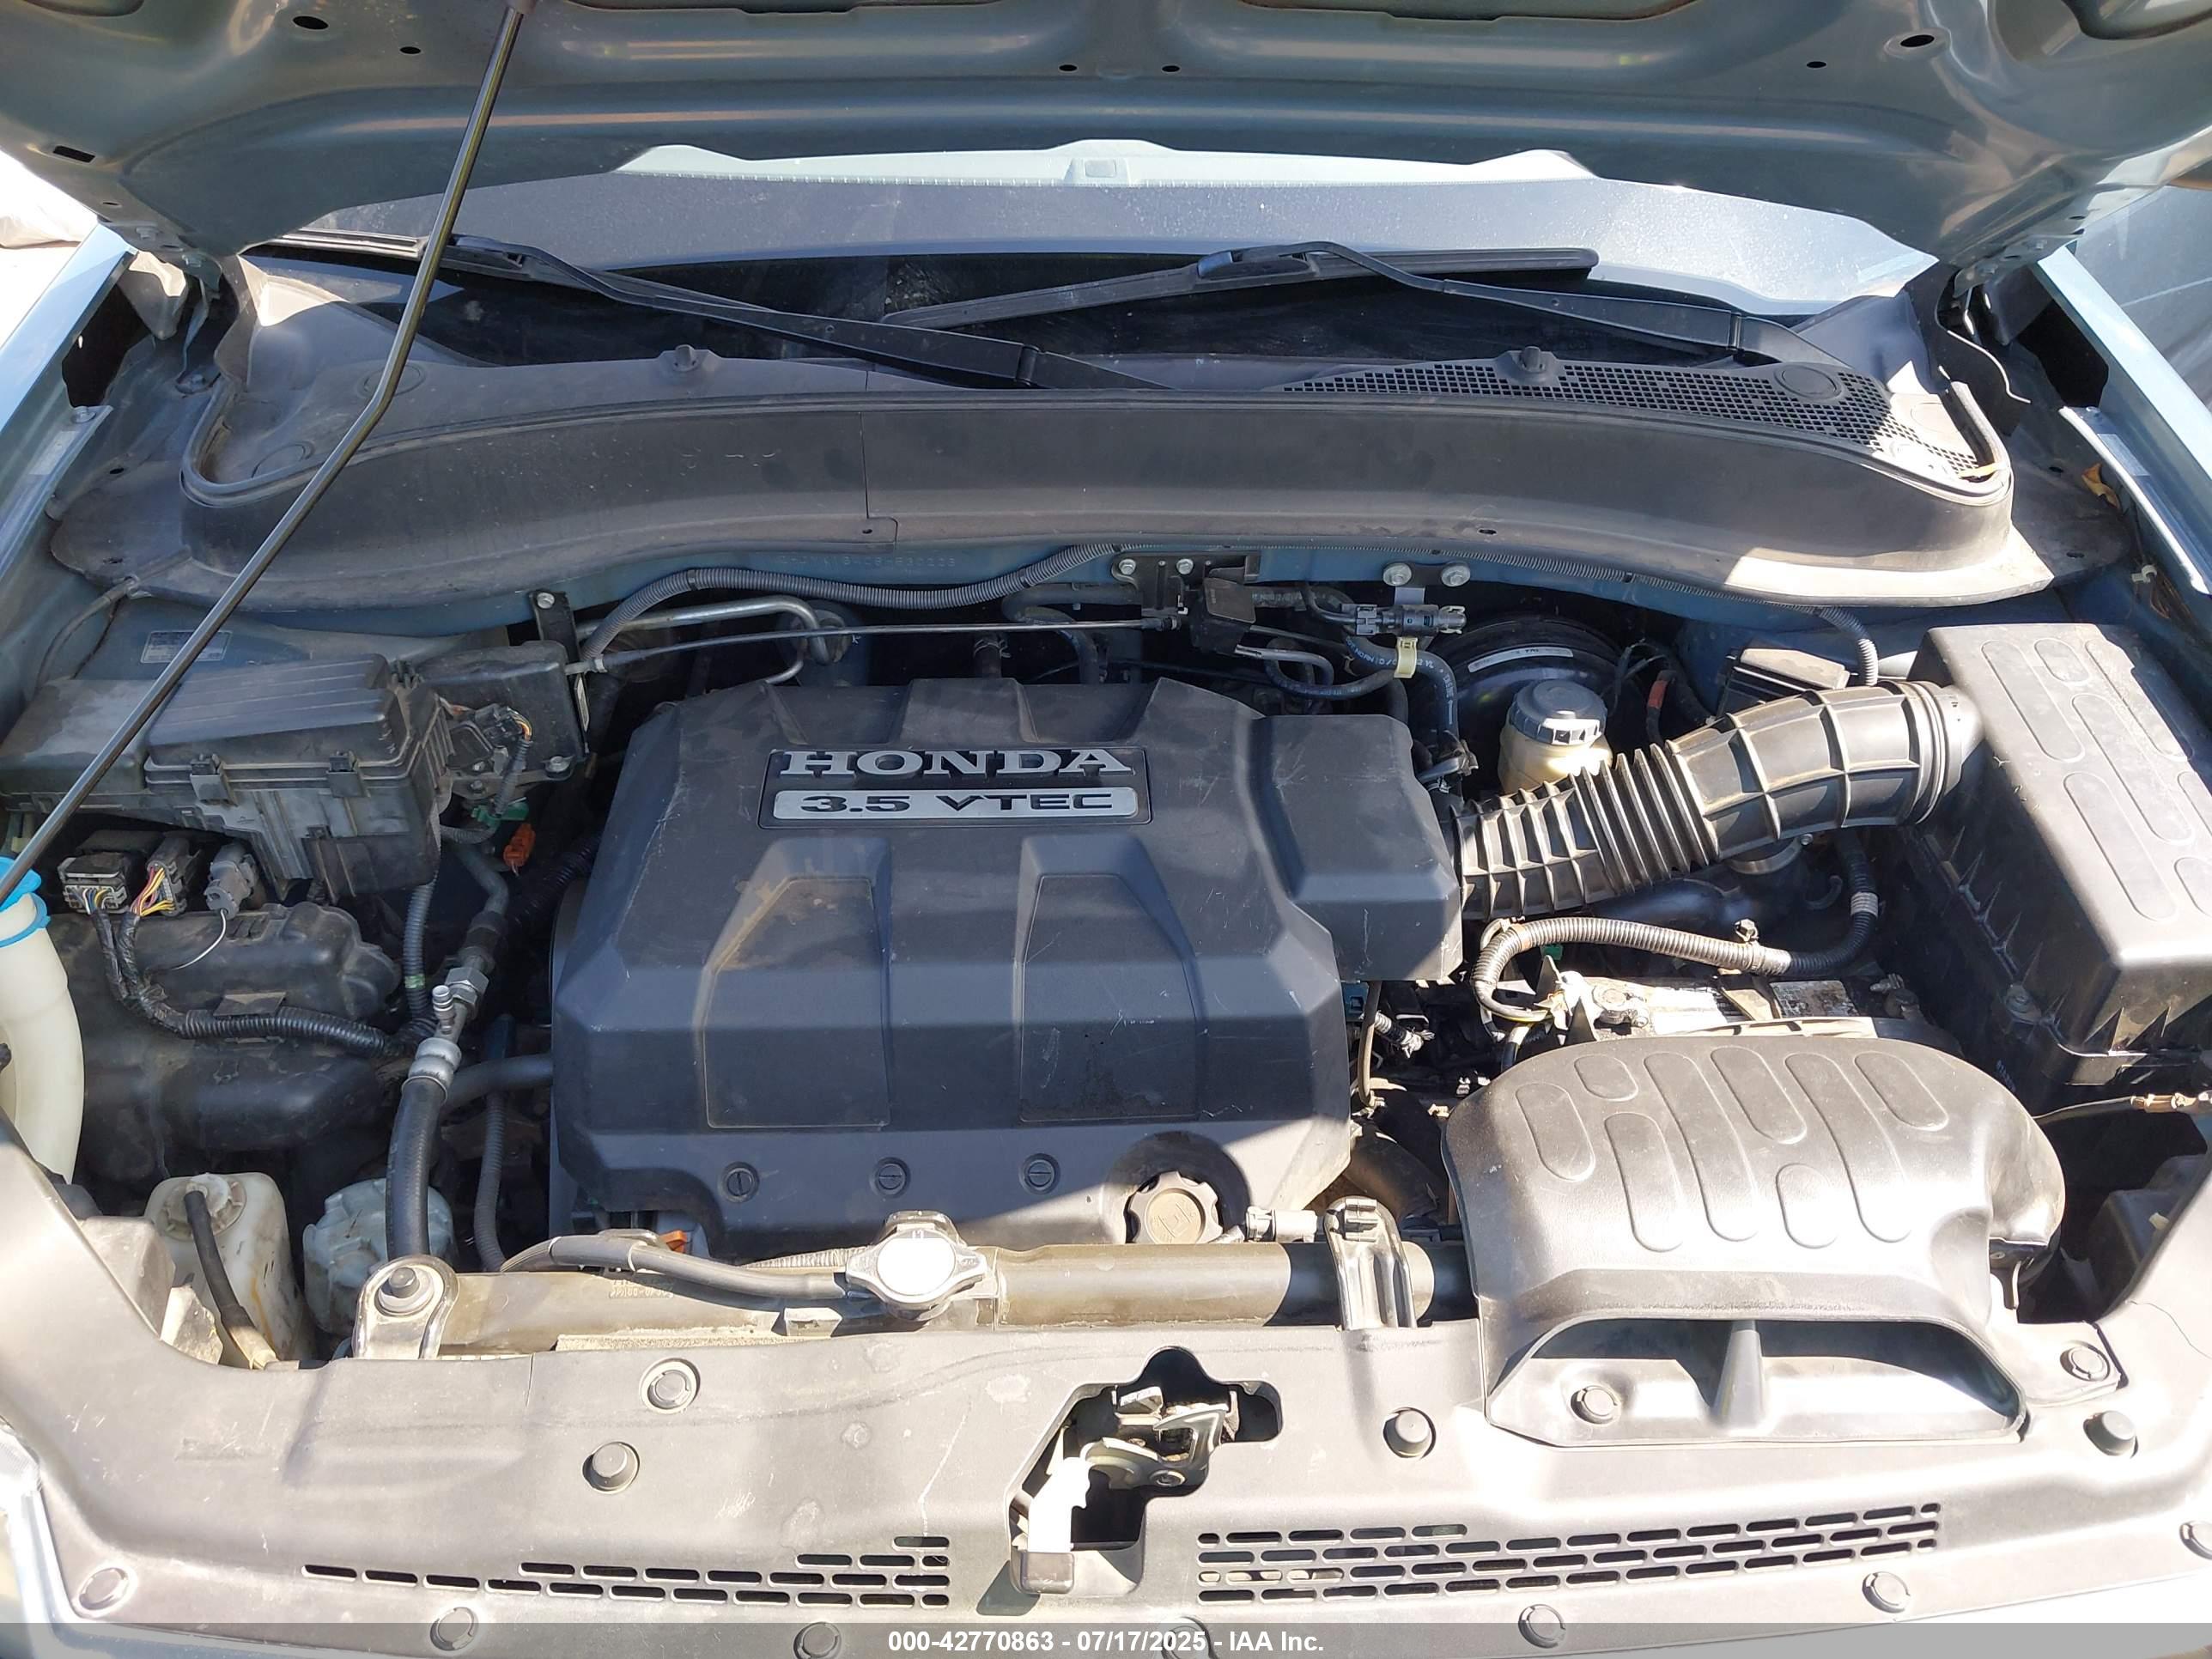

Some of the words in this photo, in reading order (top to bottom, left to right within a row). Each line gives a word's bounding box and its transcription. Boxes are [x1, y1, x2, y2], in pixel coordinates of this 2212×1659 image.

[780, 750, 1135, 776] HONDA
[800, 795, 911, 812] 3.5
[935, 793, 1113, 811] VTEC
